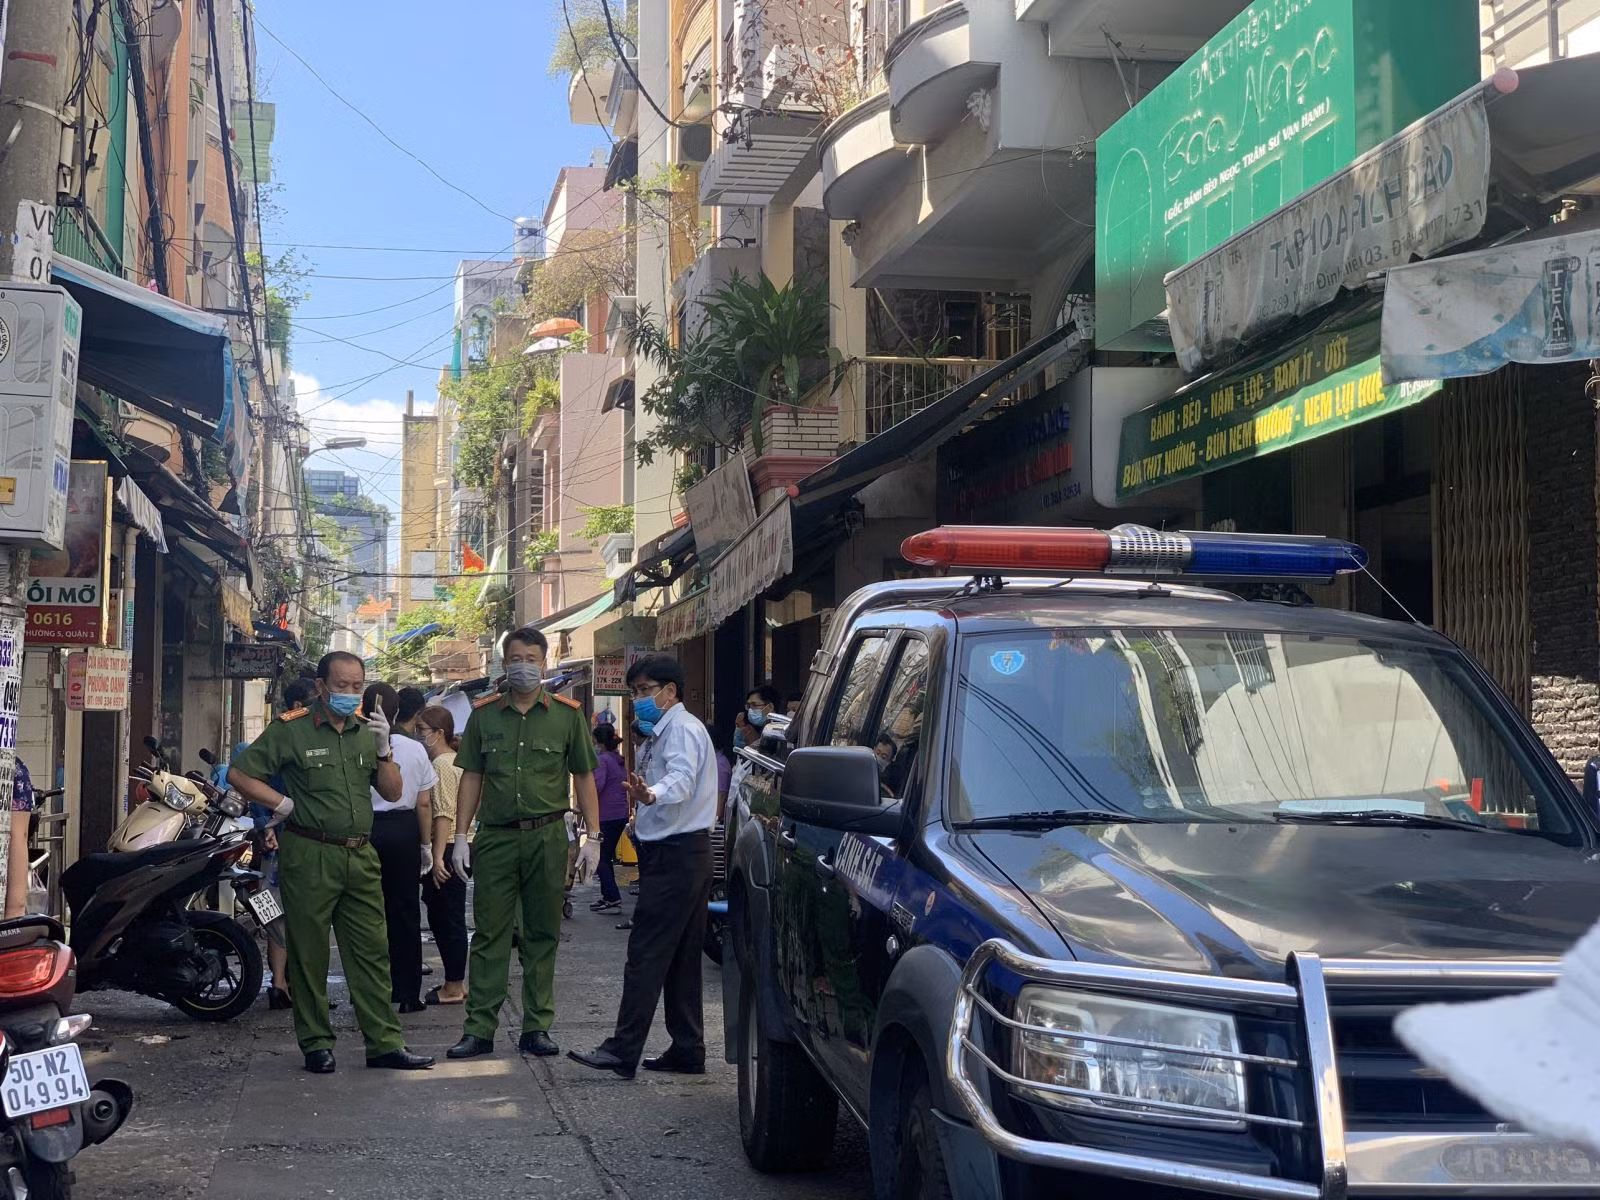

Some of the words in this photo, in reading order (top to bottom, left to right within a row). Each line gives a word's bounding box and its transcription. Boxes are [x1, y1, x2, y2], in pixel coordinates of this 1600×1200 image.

[1219, 161, 1241, 185] NGỌC
[1150, 409, 1175, 442] BÁNH
[1182, 397, 1200, 429] BÈO
[1243, 372, 1264, 408] LỌC
[1143, 453, 1162, 483] THỊT
[1206, 427, 1227, 461] BÚN
[1229, 420, 1252, 453] NEM
[1255, 403, 1294, 444] NƯỚNG
[1304, 389, 1333, 427] NEM
[1335, 380, 1355, 420] LỤI
[27, 579, 52, 602] ỐI
[33, 612, 72, 625] 0616
[25, 629, 55, 637] HƯỜNG
[65, 630, 88, 639] QUẬN
[0, 928, 21, 939] AMAHA
[10, 1050, 70, 1084] 50-N2
[7, 1074, 83, 1111] 049.94
